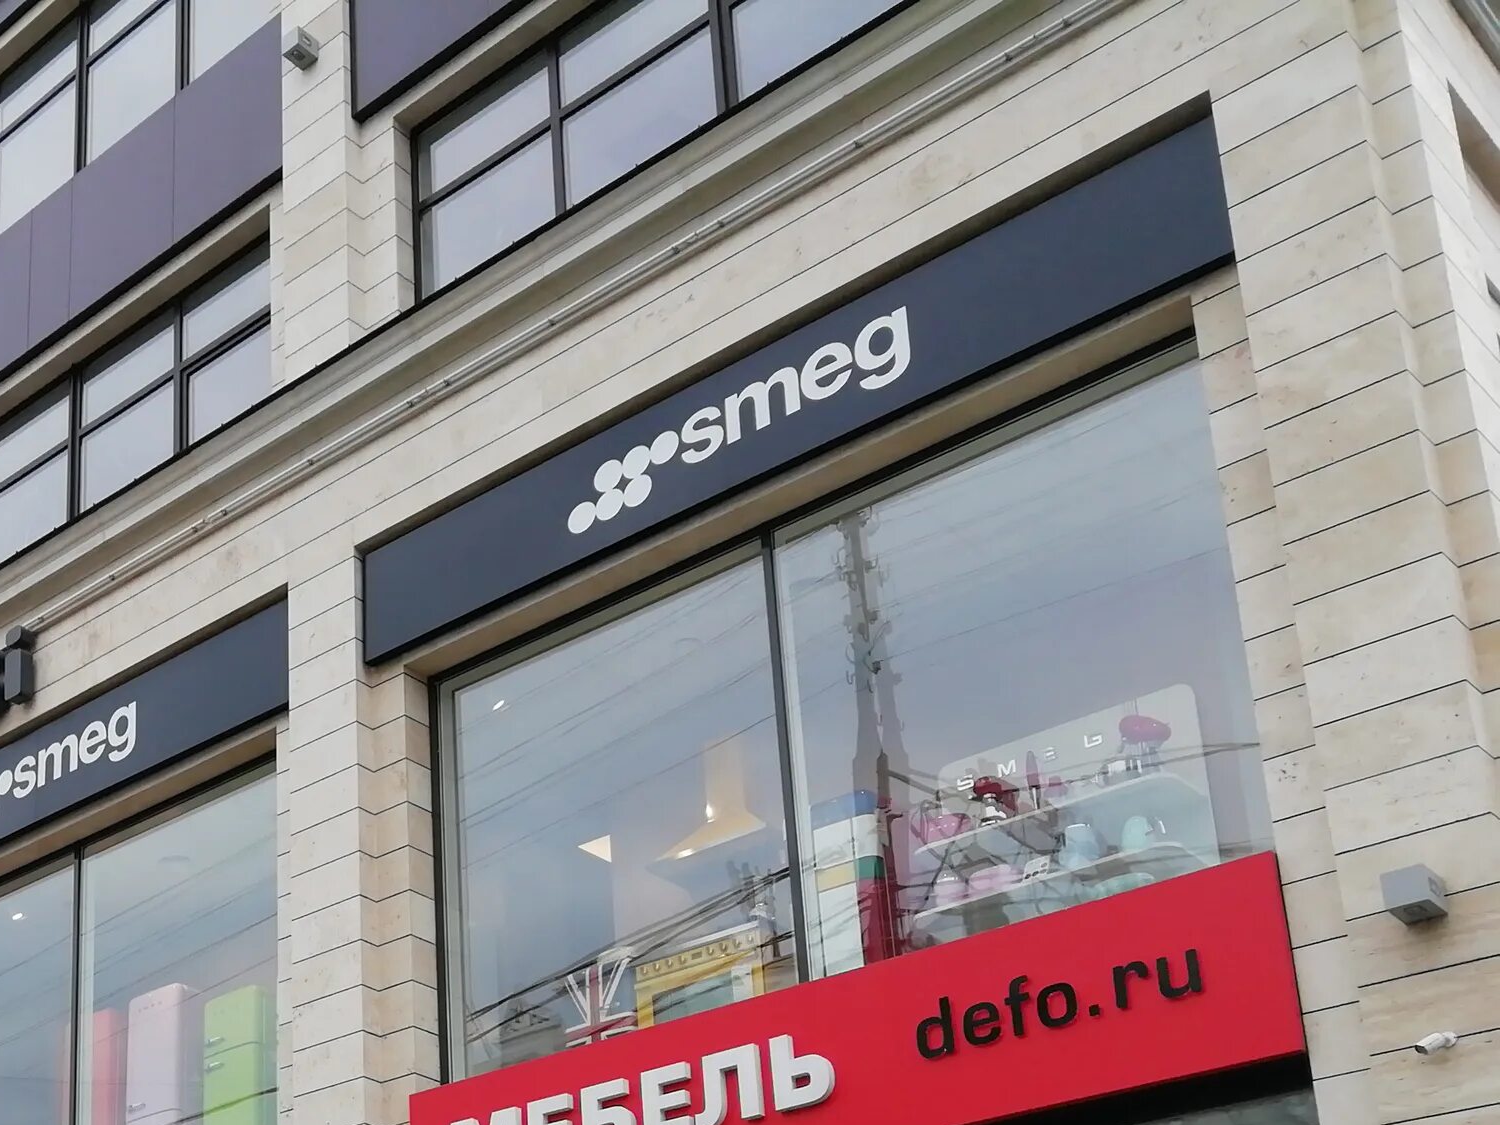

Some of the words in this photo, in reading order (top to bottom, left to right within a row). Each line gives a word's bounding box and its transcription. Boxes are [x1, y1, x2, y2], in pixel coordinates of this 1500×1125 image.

[681, 305, 911, 464] smeg
[12, 701, 138, 799] smeg
[915, 948, 1205, 1060] defo.ru
